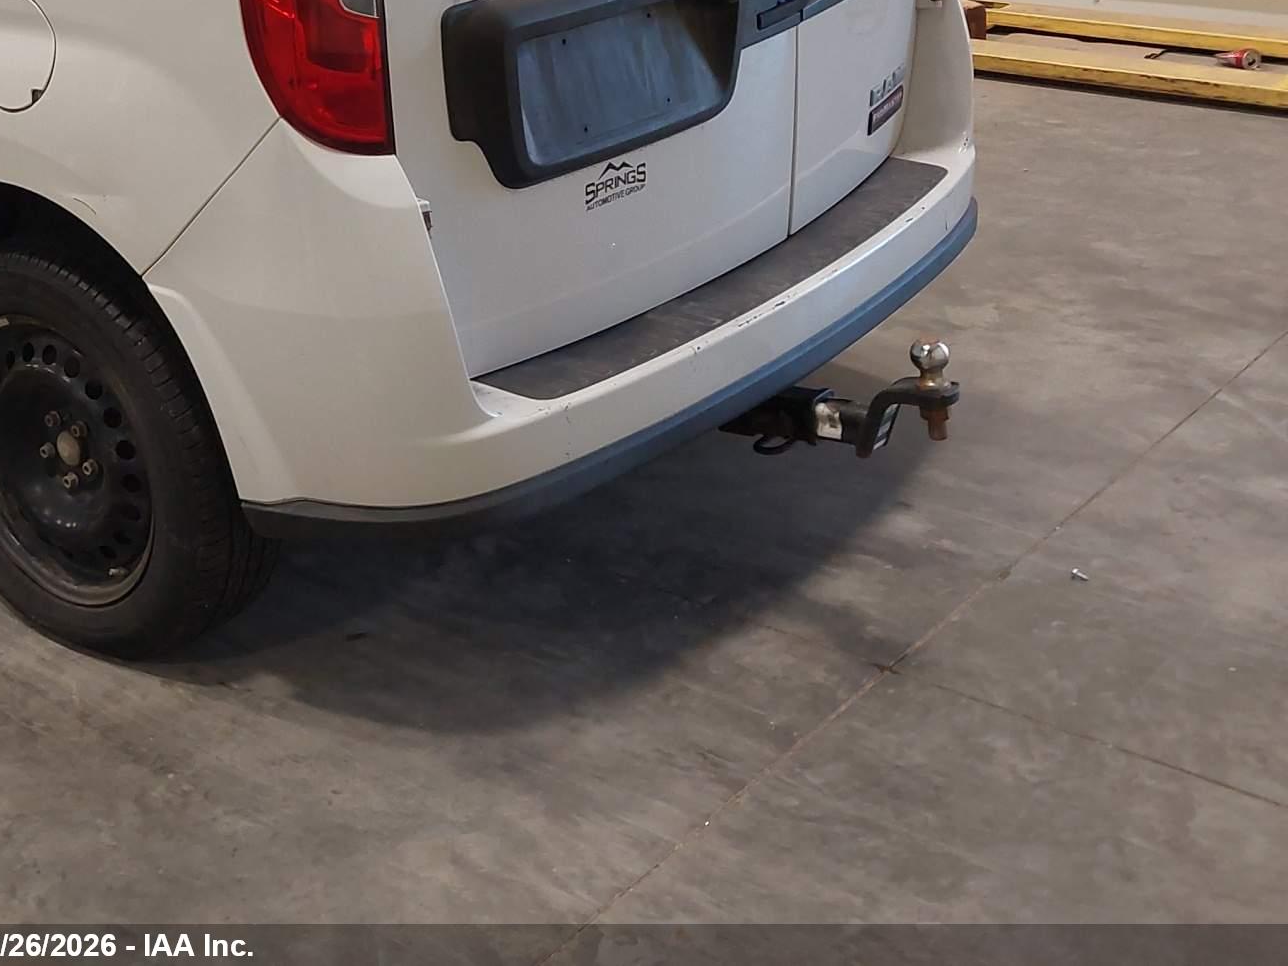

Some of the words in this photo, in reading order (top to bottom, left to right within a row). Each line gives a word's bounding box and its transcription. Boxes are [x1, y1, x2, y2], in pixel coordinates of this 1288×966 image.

[585, 162, 647, 205] SPRINGS
[586, 189, 625, 211] AUTOMOTIVE
[625, 184, 646, 196] GROUP
